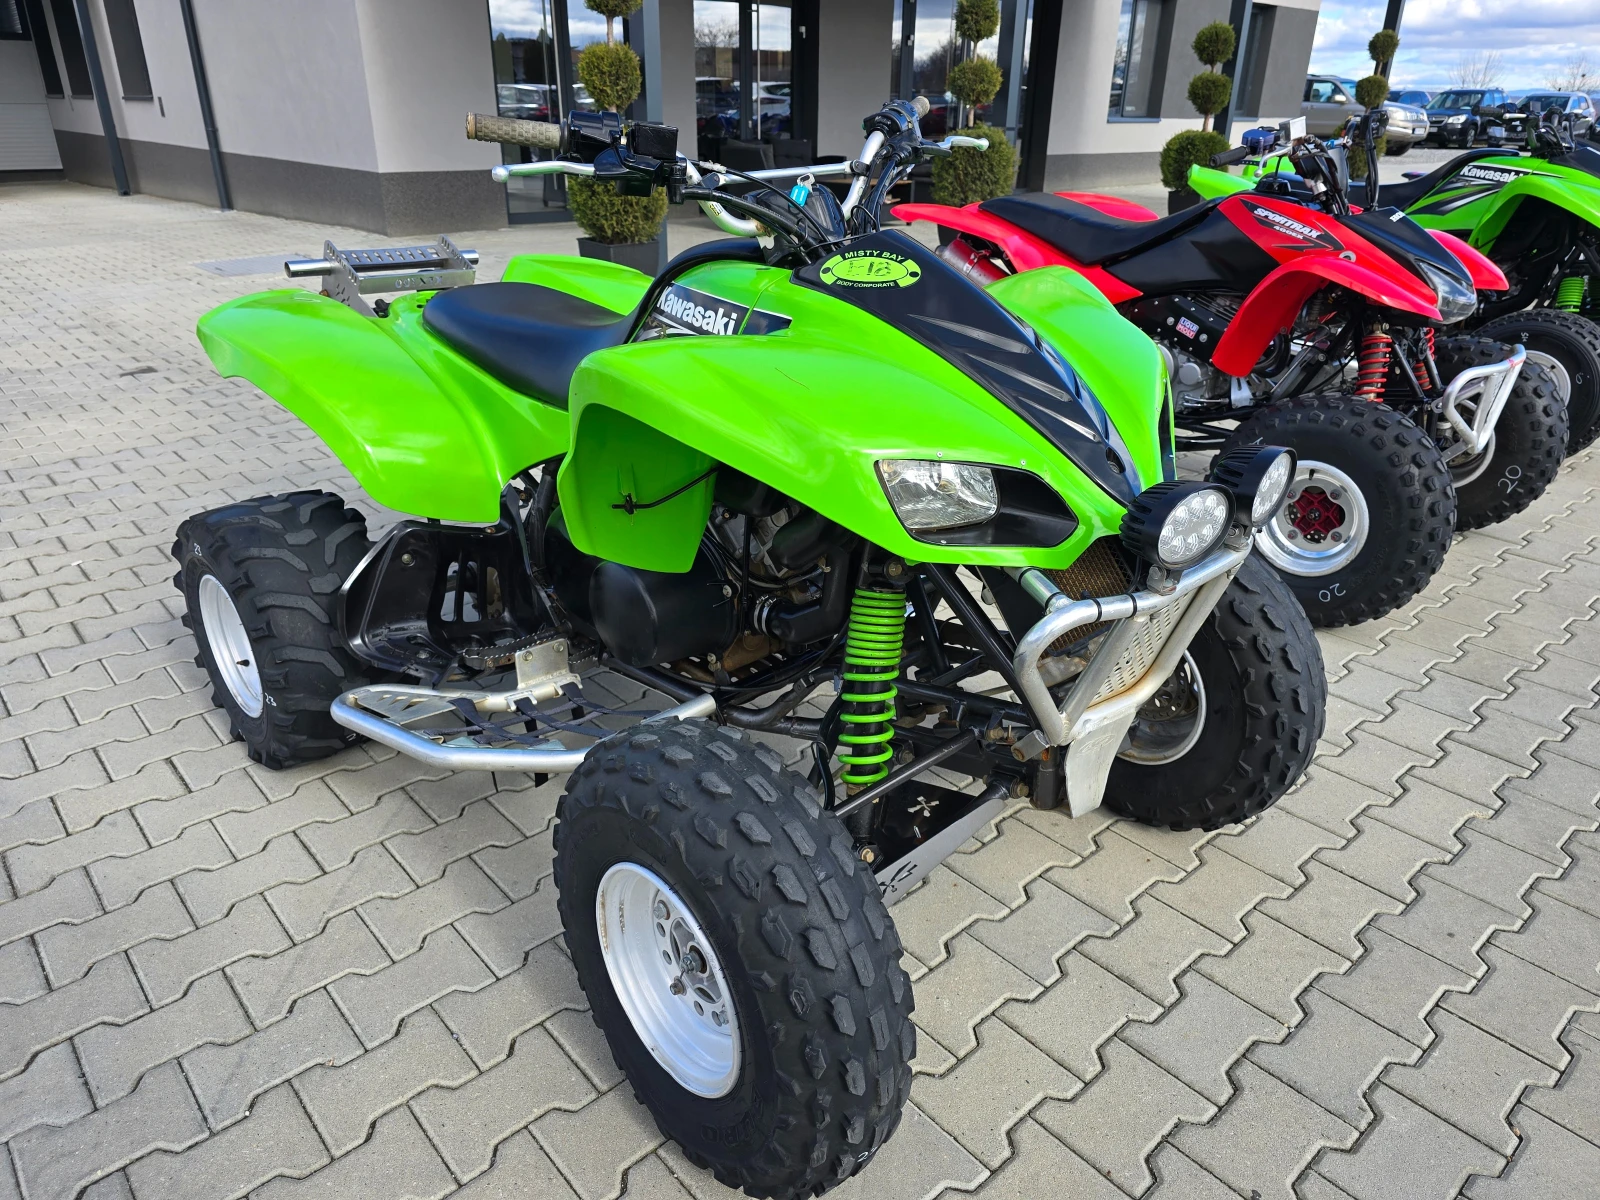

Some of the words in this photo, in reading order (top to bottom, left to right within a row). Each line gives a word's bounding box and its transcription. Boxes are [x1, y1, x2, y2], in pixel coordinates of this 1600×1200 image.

[1459, 165, 1524, 183] Kawasak
[1253, 207, 1322, 239] SPORTRAX
[844, 249, 881, 259] MISTY
[881, 251, 905, 262] BAY
[836, 279, 855, 287] BODY
[656, 285, 738, 336] Kawasaki
[1497, 464, 1522, 494] 20
